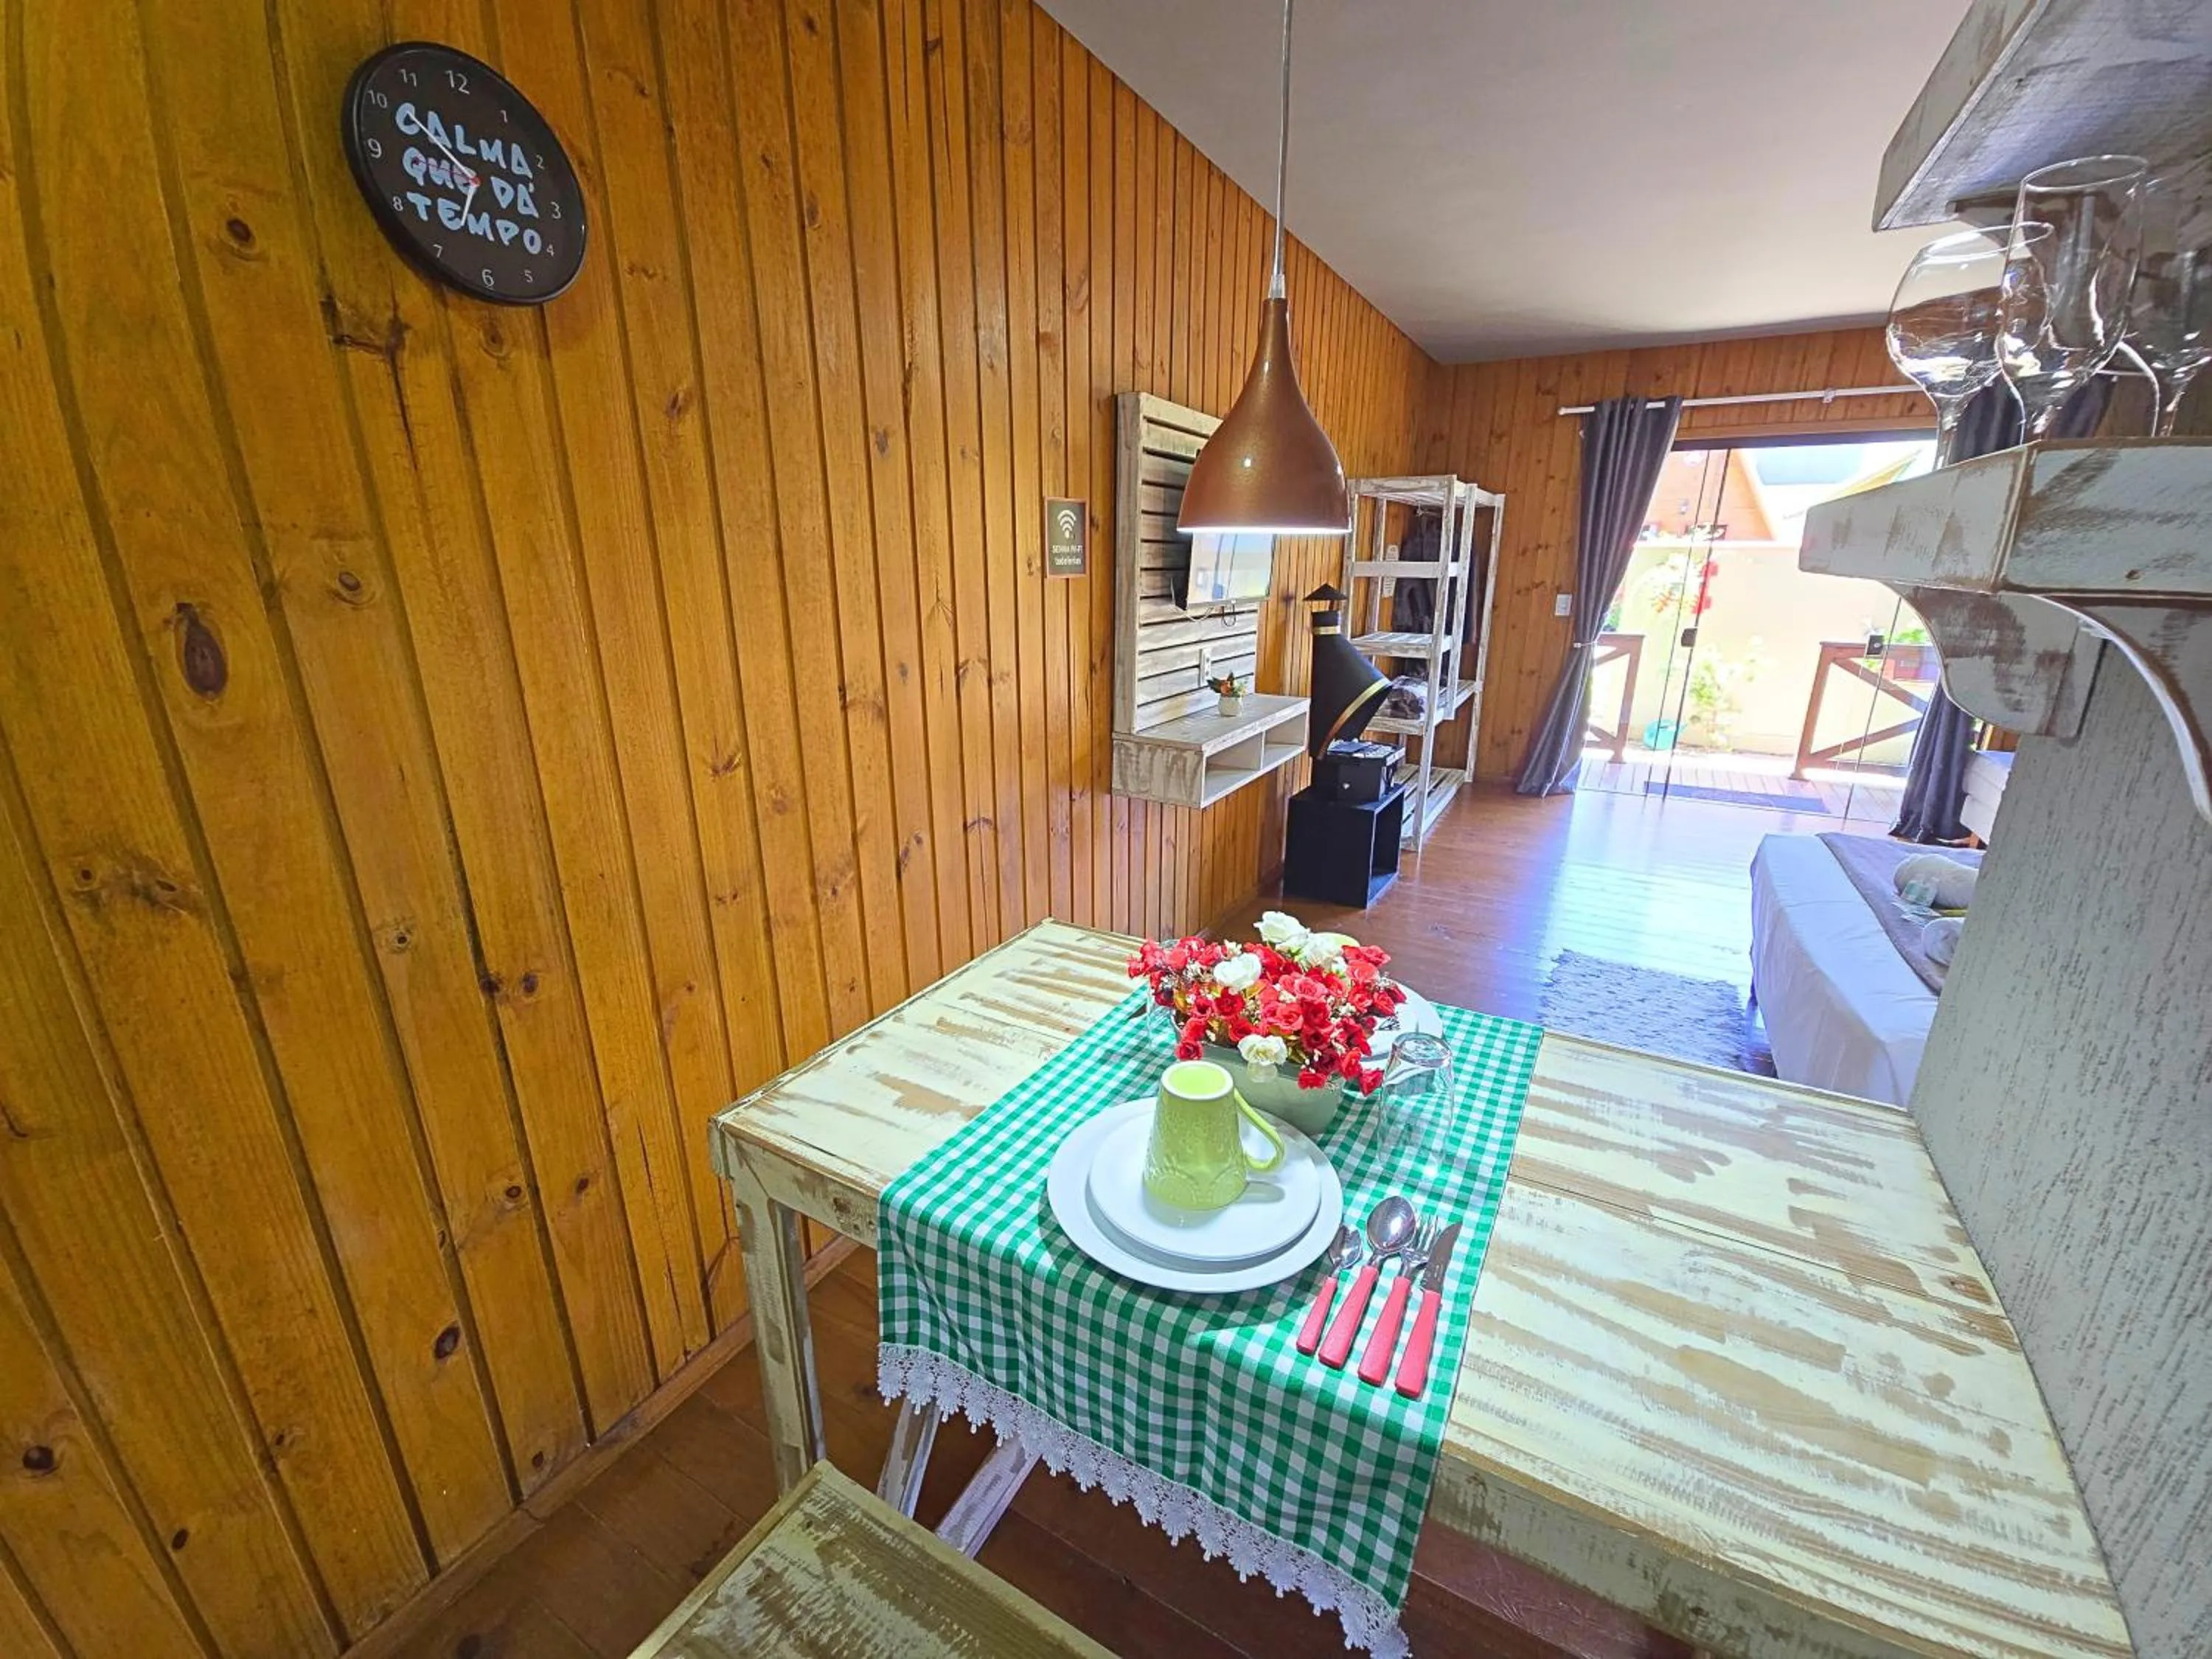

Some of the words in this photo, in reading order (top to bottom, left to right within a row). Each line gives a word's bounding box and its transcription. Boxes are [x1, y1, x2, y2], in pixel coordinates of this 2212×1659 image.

[399, 69, 417, 87] 11
[445, 70, 470, 95] 12
[369, 90, 387, 109] 10
[501, 110, 508, 123] 1
[369, 139, 382, 159] 9
[395, 103, 533, 179] CALMA
[536, 156, 544, 169] 2
[393, 196, 403, 212] 8
[552, 202, 562, 219] 3
[406, 192, 541, 254] TEMPO
[434, 245, 442, 258] 7
[547, 245, 554, 257] 4
[481, 269, 494, 288] 6
[525, 271, 532, 283] 5
